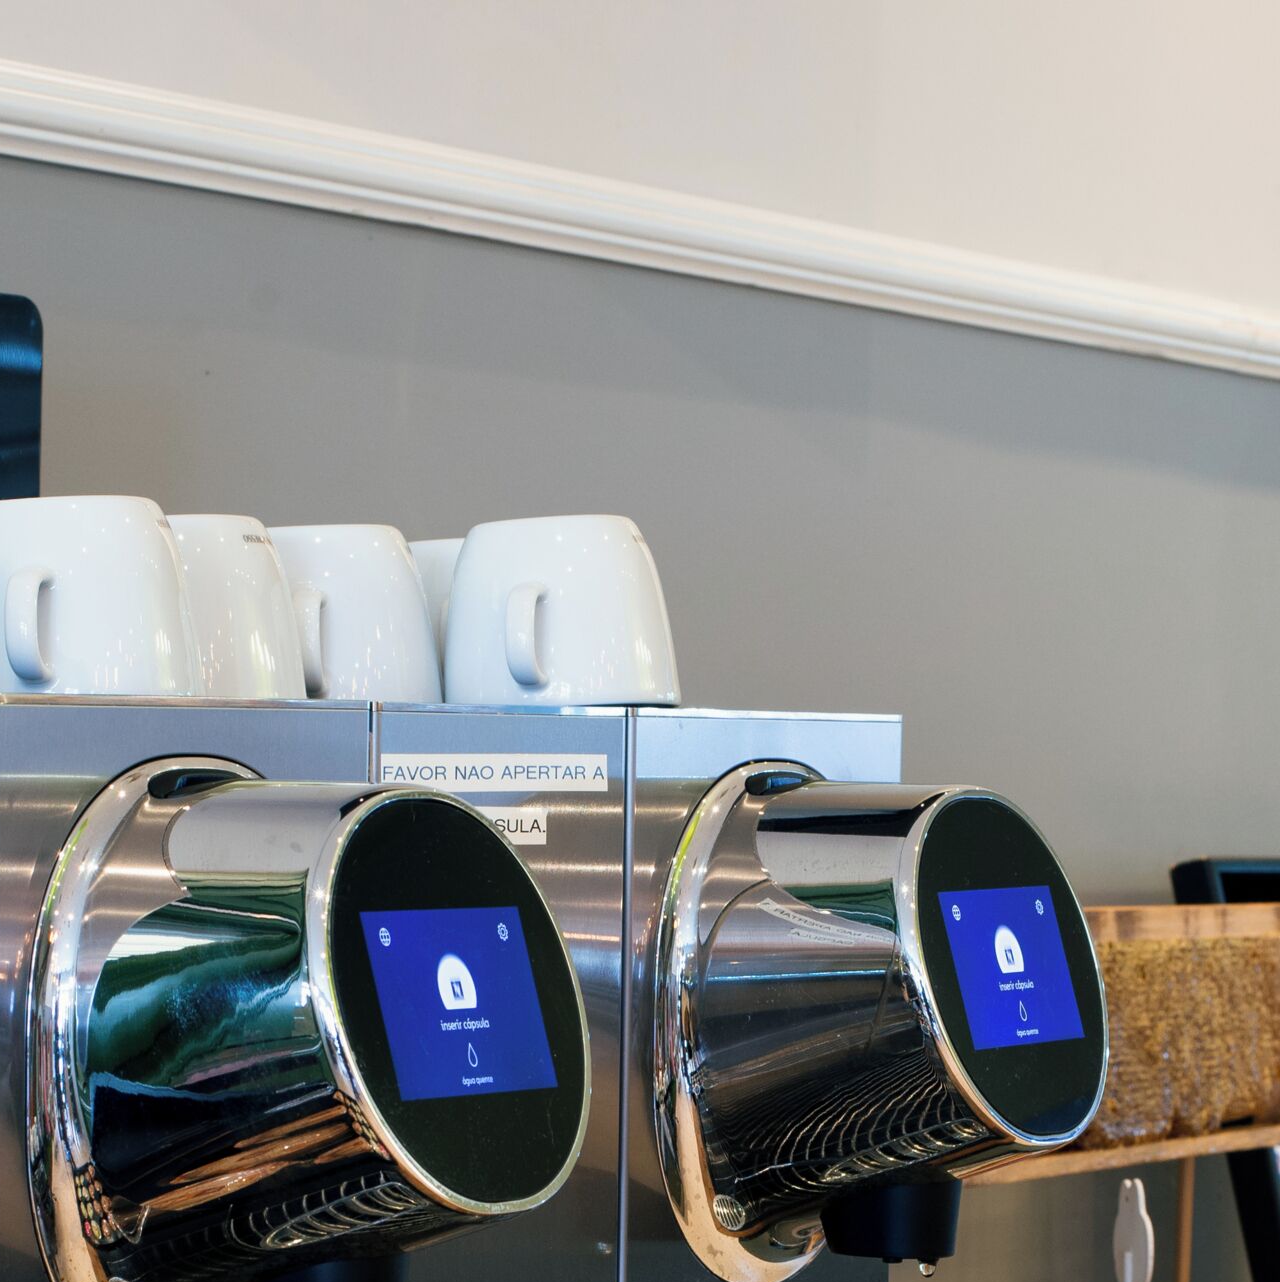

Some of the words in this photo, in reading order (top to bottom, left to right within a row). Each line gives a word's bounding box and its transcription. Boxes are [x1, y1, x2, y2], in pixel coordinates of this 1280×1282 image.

[383, 766, 447, 781] FAVOR
[454, 765, 494, 780] NAO
[501, 765, 586, 780] APERTAR
[593, 766, 605, 780] A
[490, 819, 546, 833] SULA.
[440, 1020, 462, 1031] inserir
[463, 1017, 490, 1032] cápsula
